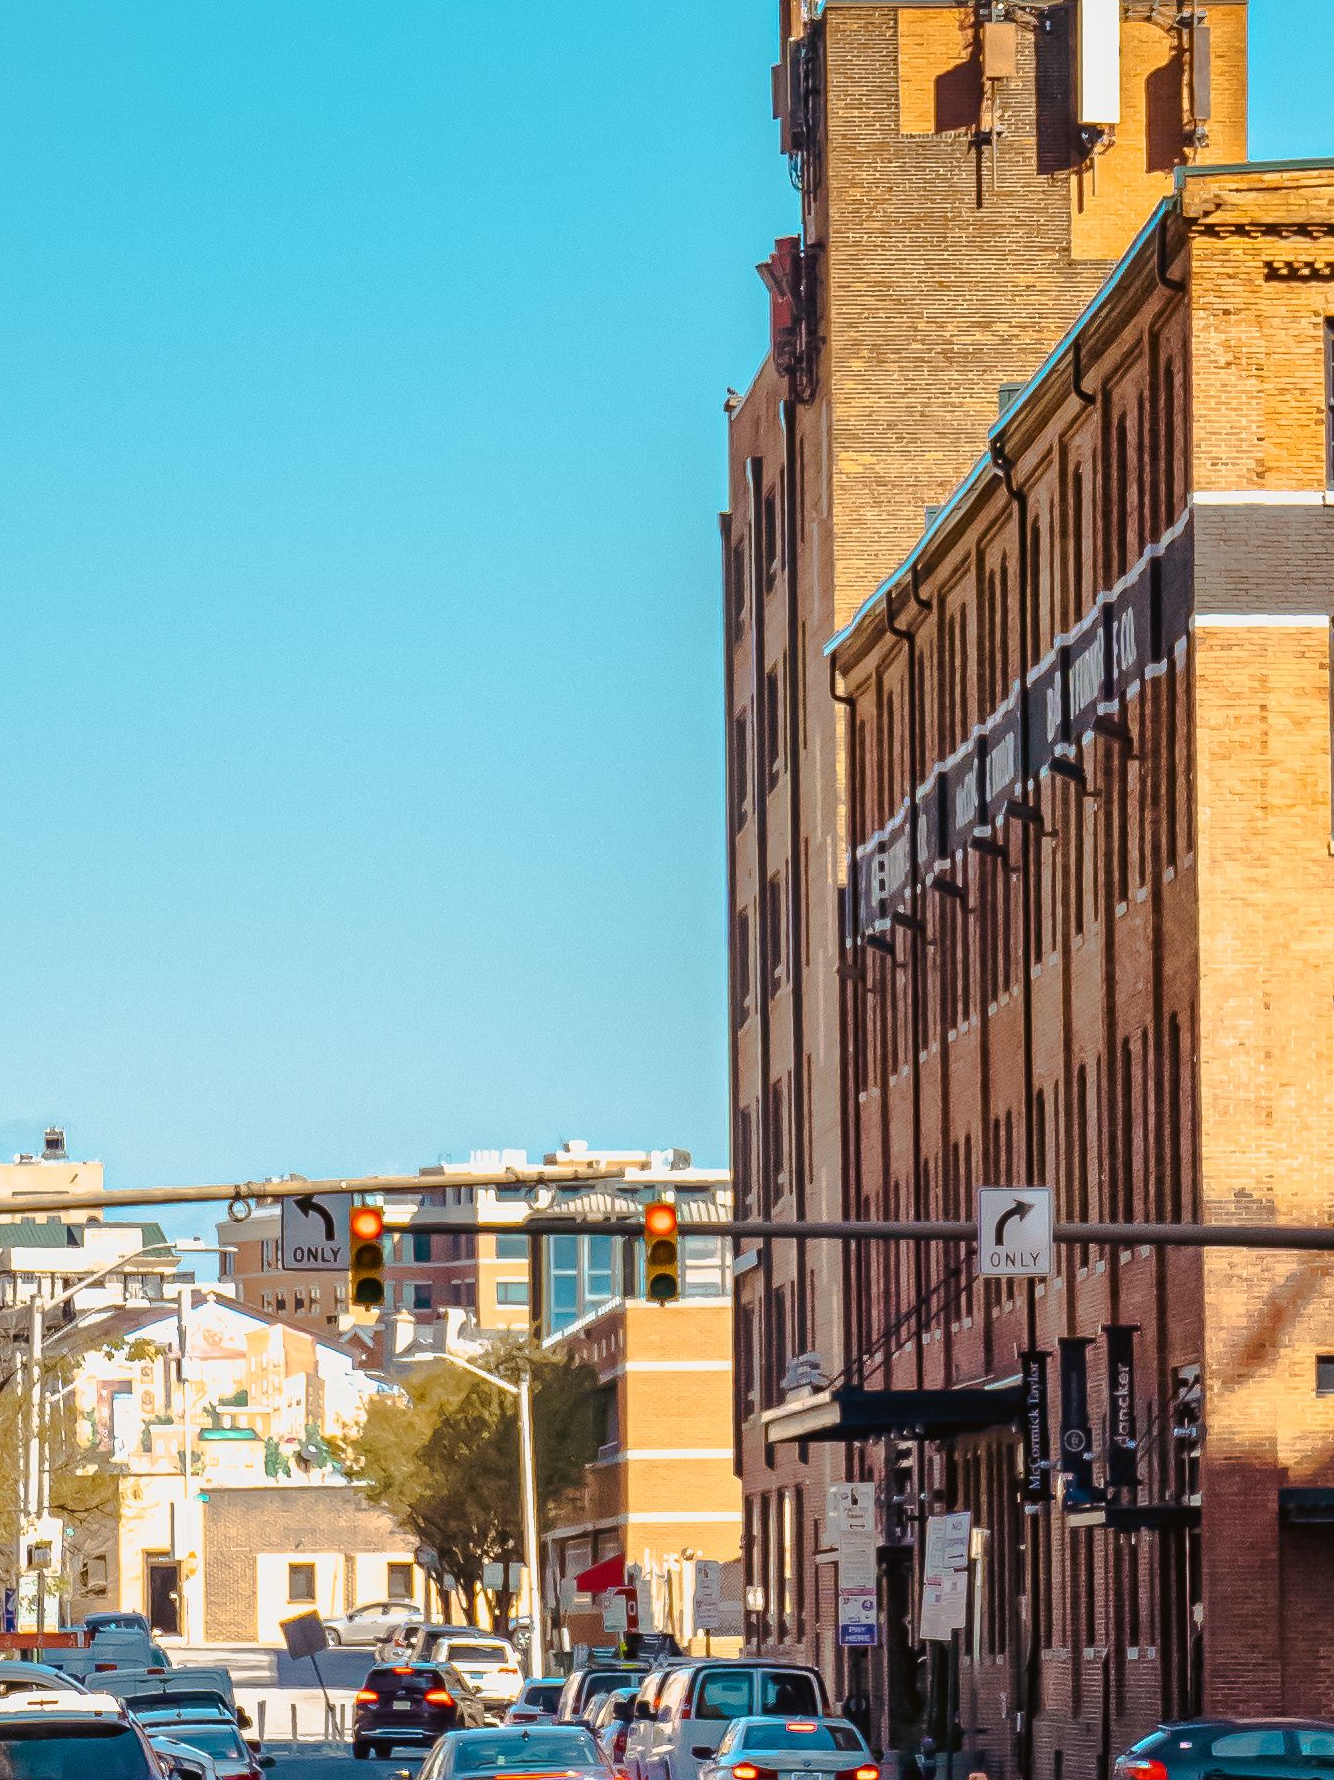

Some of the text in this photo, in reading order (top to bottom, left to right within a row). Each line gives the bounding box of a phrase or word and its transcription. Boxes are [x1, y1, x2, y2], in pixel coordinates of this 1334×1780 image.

[293, 1246, 342, 1263] ONLY
[990, 1251, 1041, 1268] ONLY
[1027, 1361, 1040, 1406] Taylor
